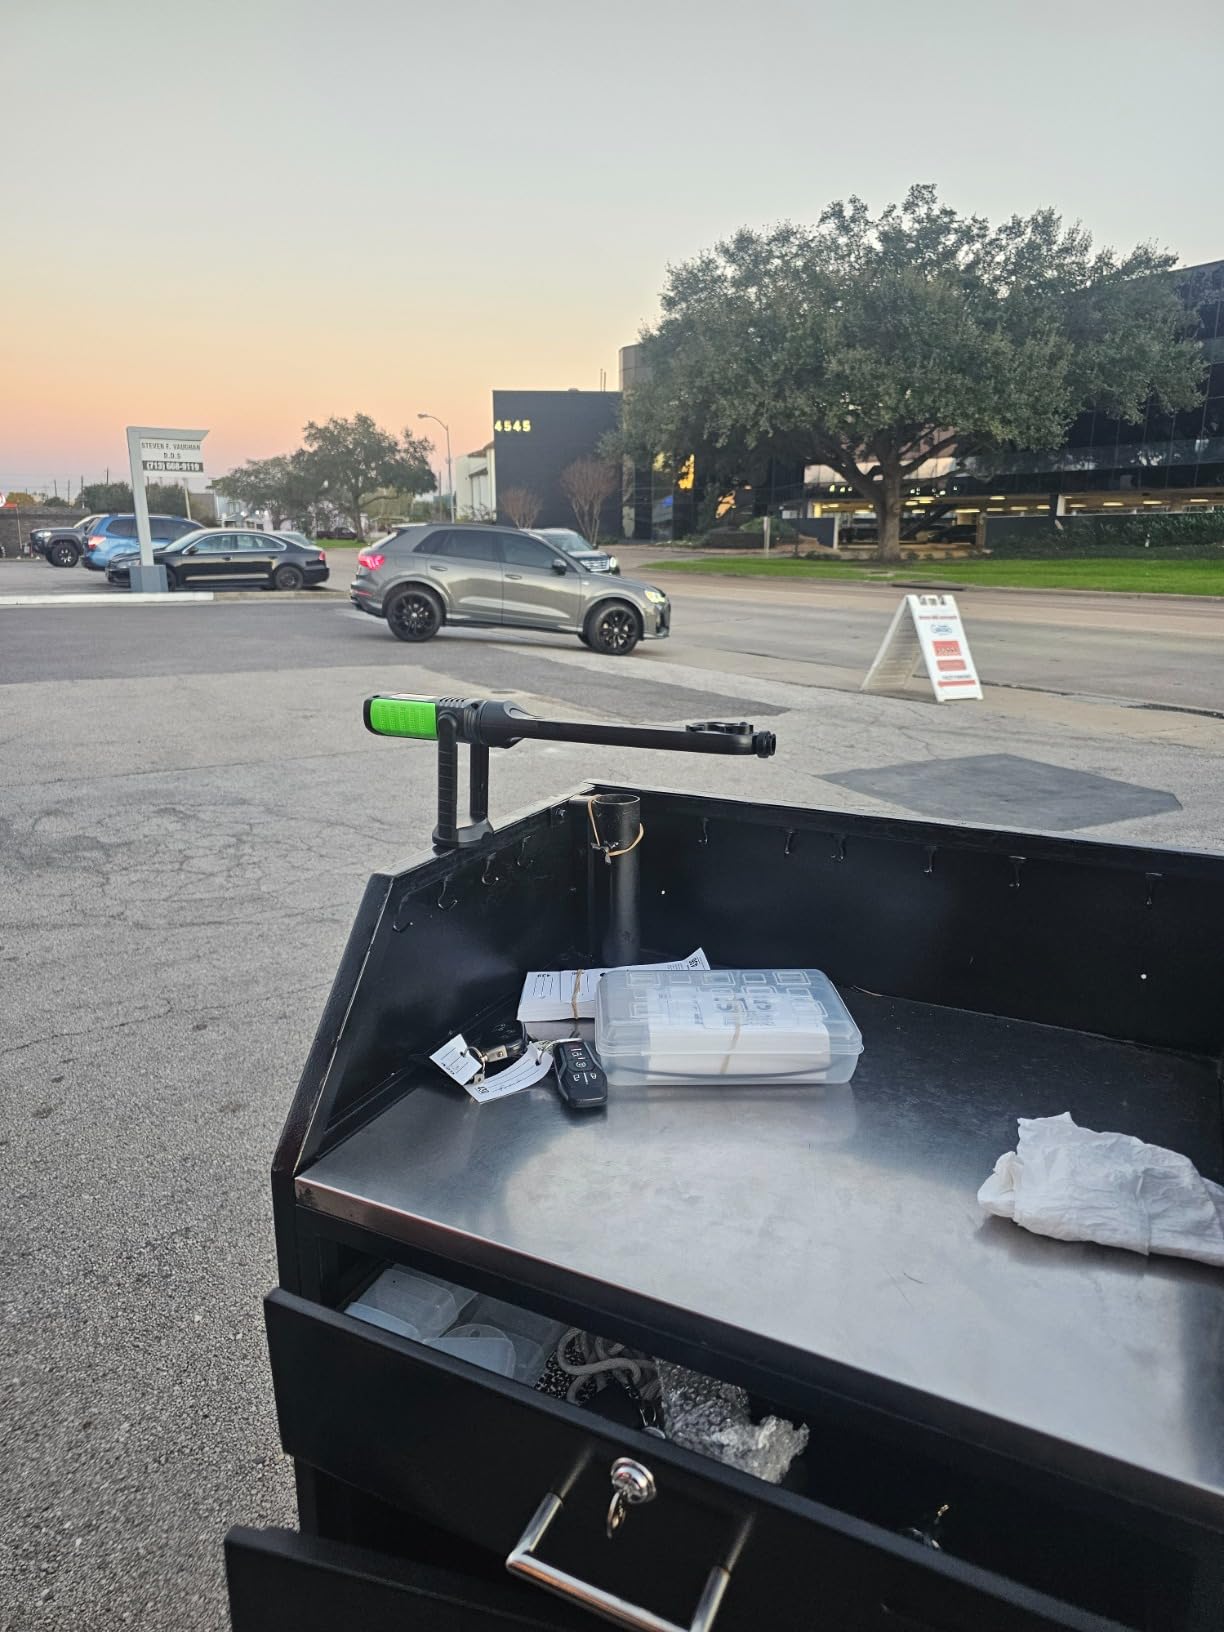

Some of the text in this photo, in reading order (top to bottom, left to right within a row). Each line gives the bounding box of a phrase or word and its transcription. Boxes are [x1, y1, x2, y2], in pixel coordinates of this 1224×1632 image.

[494, 419, 531, 432] 4545
[141, 442, 164, 450] STEVEN
[146, 461, 165, 470] (713)
